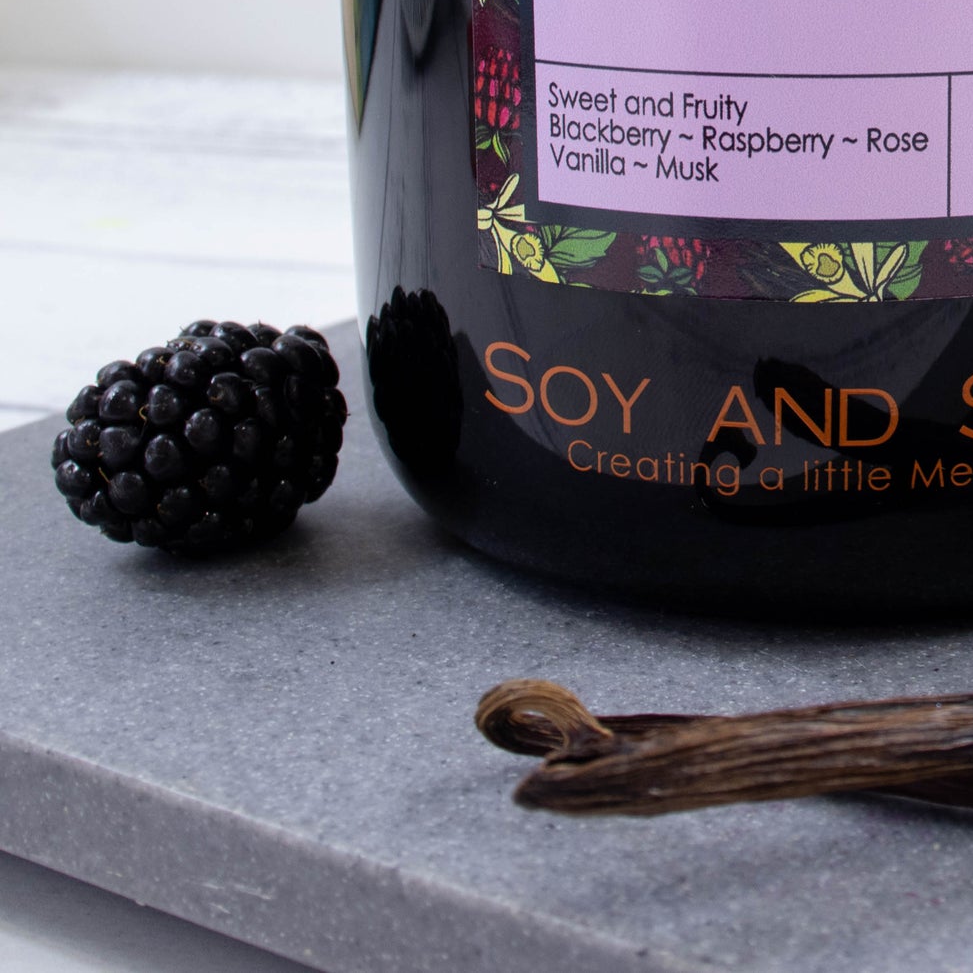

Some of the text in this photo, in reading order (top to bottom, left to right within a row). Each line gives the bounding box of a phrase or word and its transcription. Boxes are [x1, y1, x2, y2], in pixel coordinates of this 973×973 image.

[548, 81, 749, 127] Sweet and Fruity
[549, 113, 672, 154] Blackberry
[702, 125, 835, 160] Raspberry
[866, 127, 929, 153] Rose
[549, 142, 626, 176] Vanilla
[655, 154, 720, 183] Musk
[484, 341, 650, 434] SOY
[706, 385, 900, 448] AND
[567, 439, 741, 497] Creating
[759, 466, 784, 491] a
[804, 460, 892, 492] little
[911, 459, 973, 488] Me
